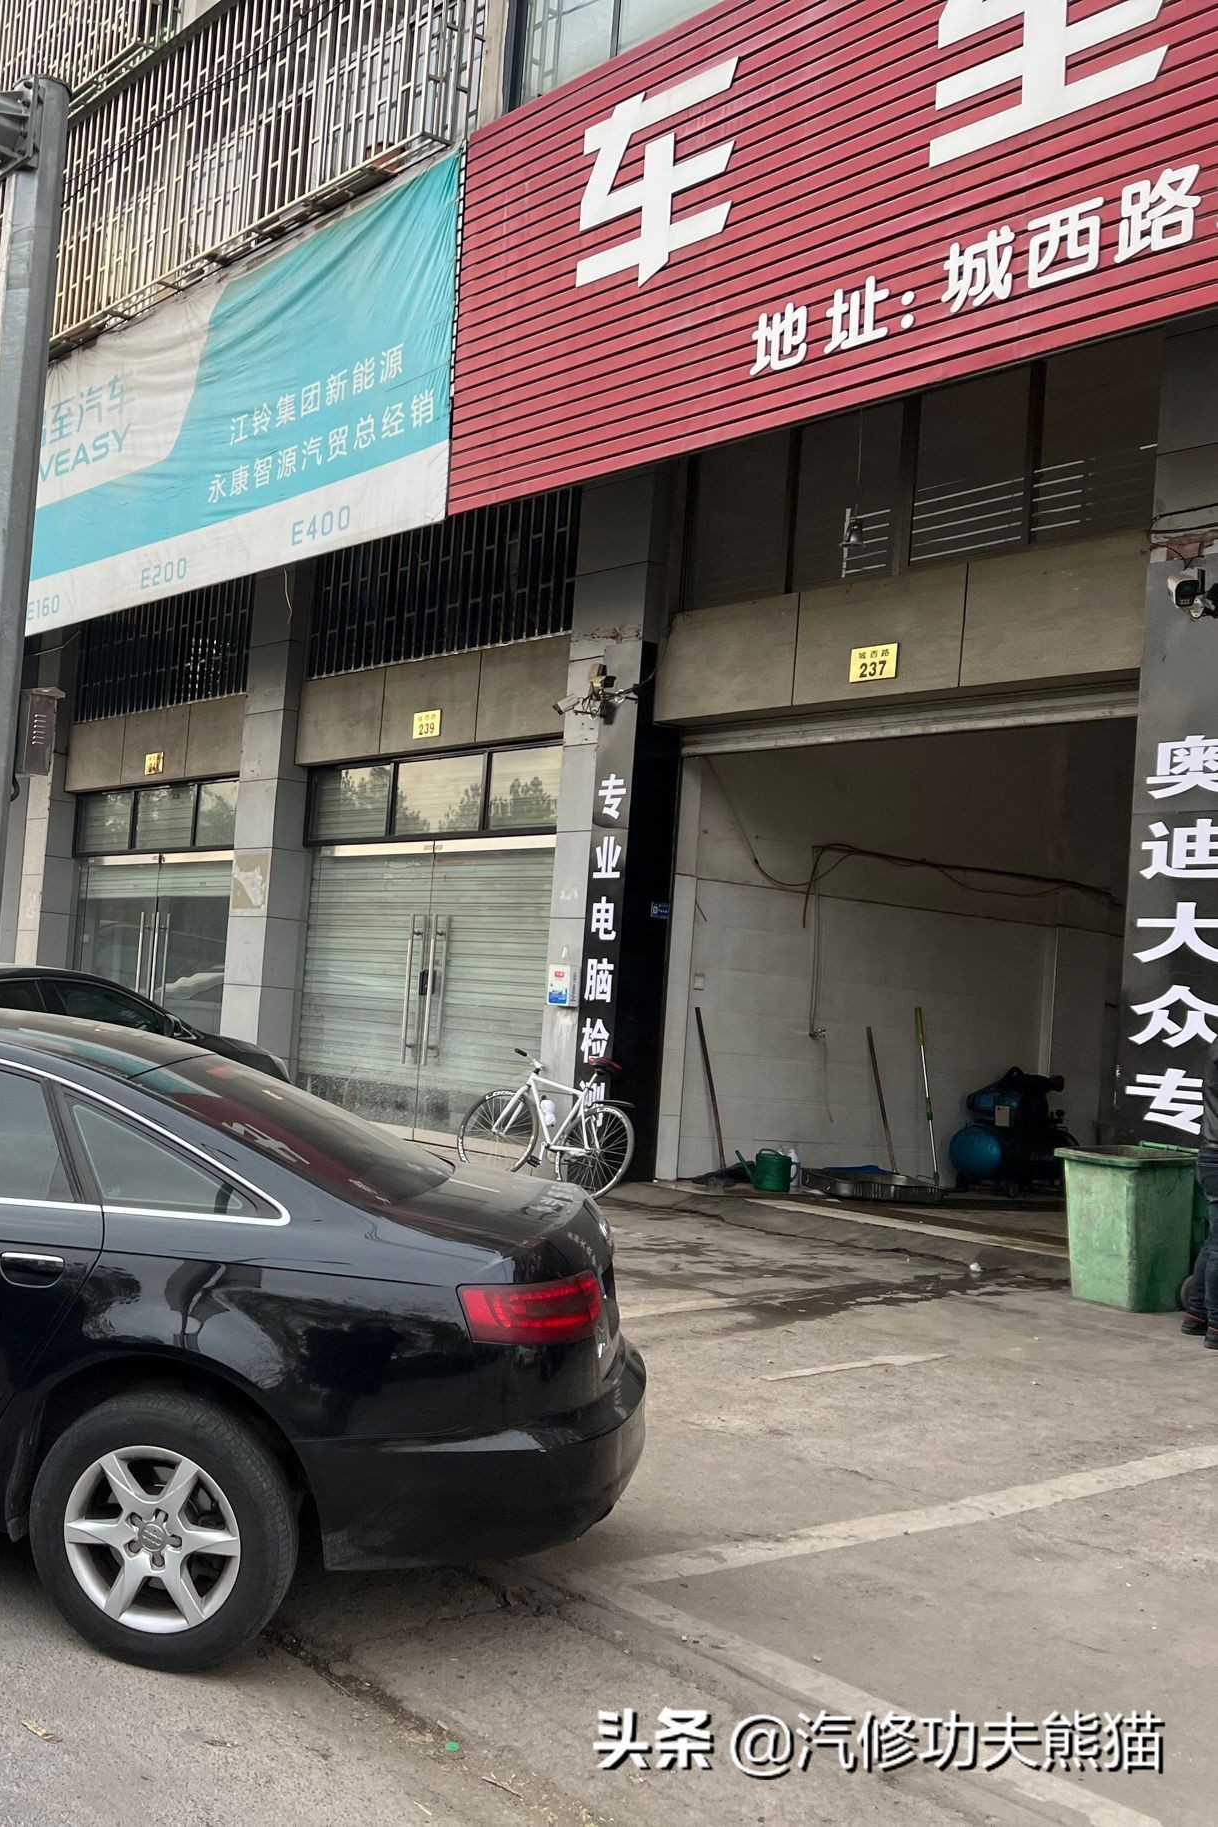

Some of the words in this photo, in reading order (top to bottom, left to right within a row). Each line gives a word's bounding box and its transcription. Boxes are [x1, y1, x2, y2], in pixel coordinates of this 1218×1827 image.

[42, 375, 136, 447] 至汽车
[229, 344, 404, 446] 江铃集团新能源
[208, 388, 435, 503] 永康智源汽贸总经销
[292, 505, 351, 546] E400
[141, 557, 187, 589] E200
[27, 594, 61, 621] E160
[858, 660, 887, 679] 237
[418, 722, 436, 736] 239
[1126, 735, 1218, 1136] 奥迪大众专
